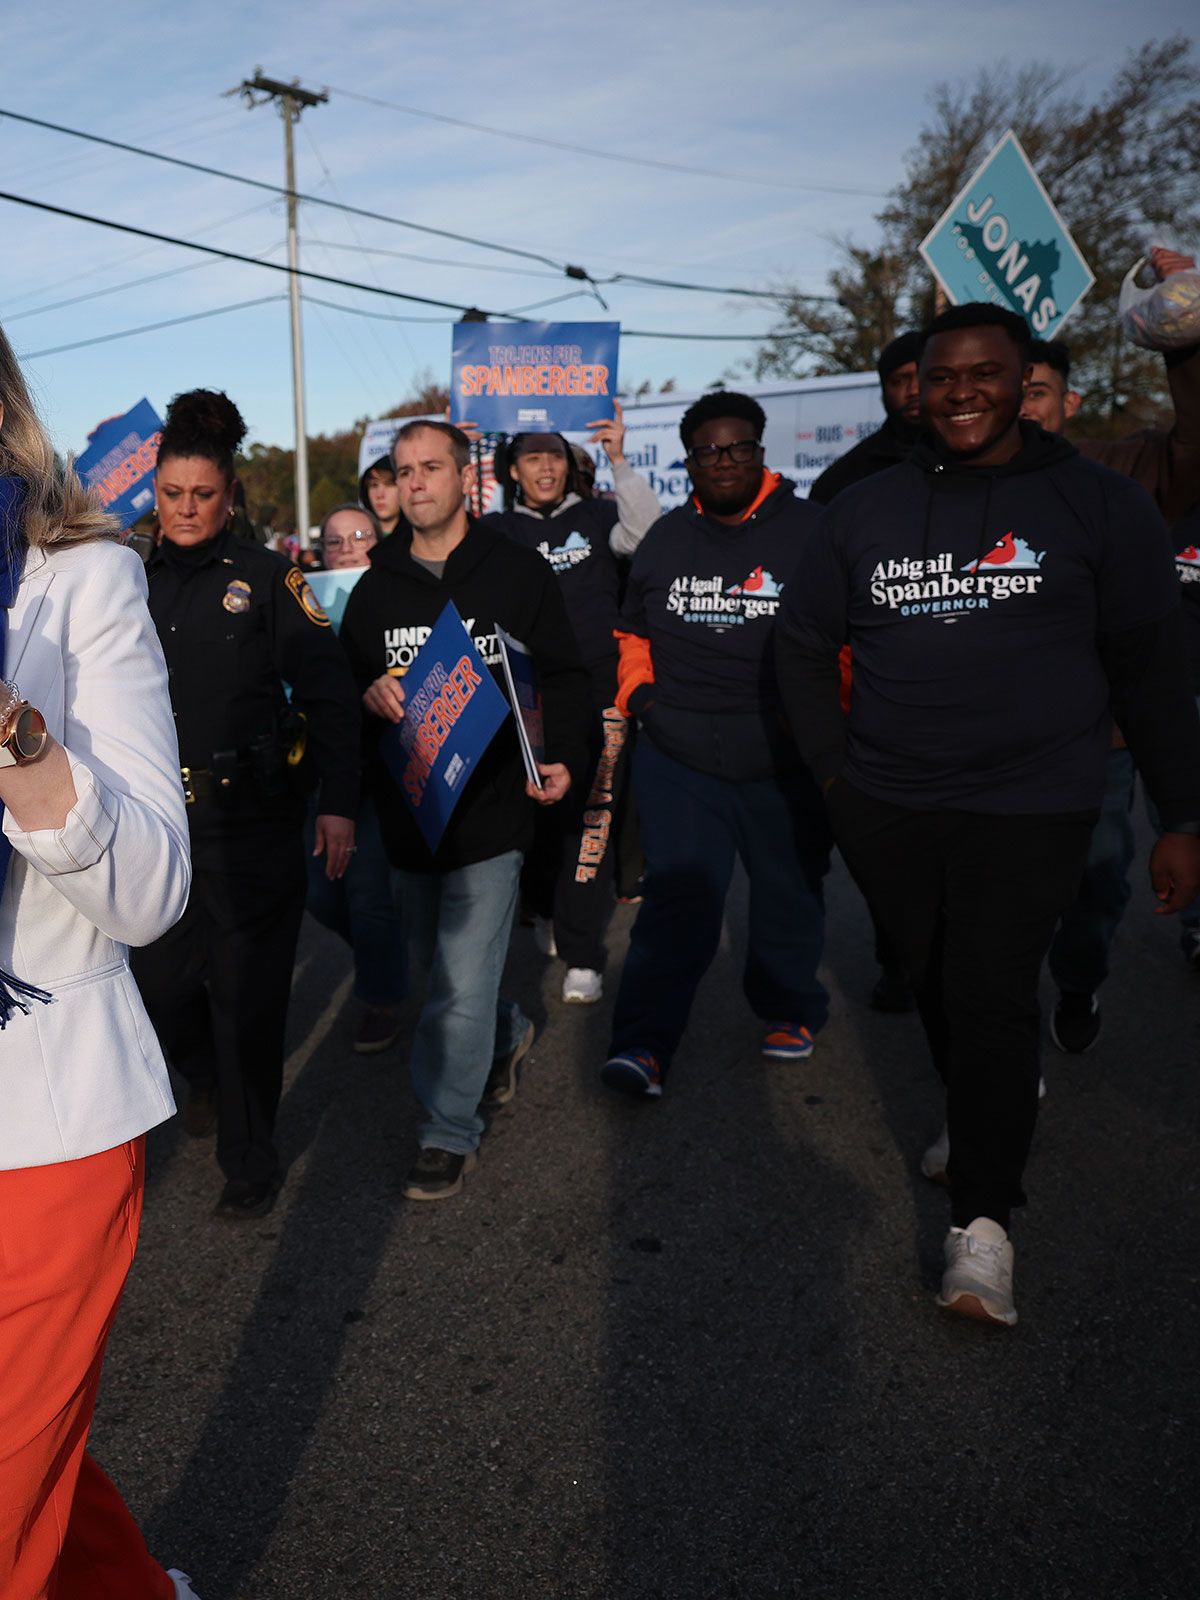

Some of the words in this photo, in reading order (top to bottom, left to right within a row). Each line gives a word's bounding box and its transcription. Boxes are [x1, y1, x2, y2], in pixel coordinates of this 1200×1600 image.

[966, 195, 1058, 333] JONAS
[460, 364, 609, 397] SPANBERGER
[870, 552, 954, 582] Abigail
[870, 572, 1043, 610] Spanberger
[683, 612, 745, 625] GOVERNOR
[900, 597, 990, 617] GOVERNOR
